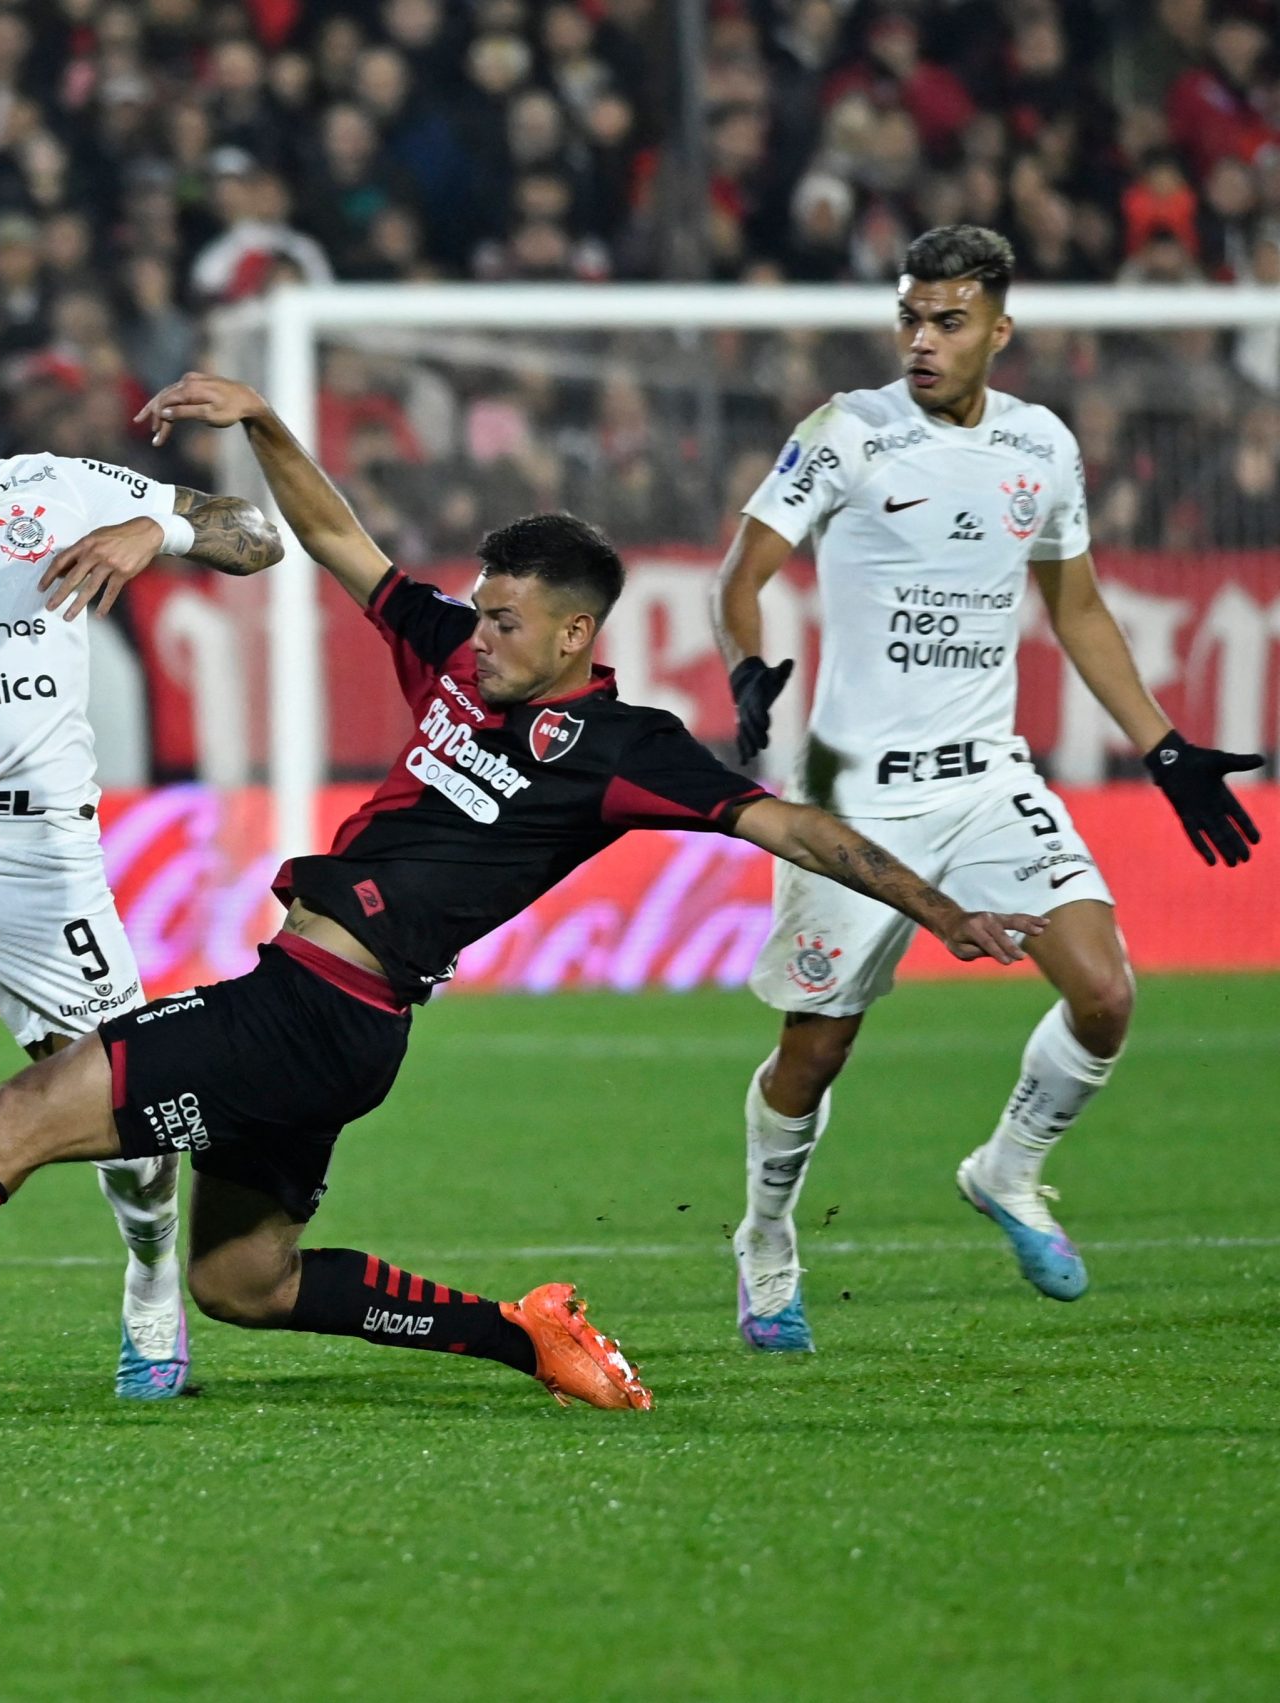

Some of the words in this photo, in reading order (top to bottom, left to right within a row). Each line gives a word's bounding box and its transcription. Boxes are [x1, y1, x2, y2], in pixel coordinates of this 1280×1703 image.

[791, 447, 840, 494] bmg
[948, 531, 986, 541] ALE
[894, 584, 1014, 610] vitaminas
[889, 610, 960, 637] neo
[887, 638, 1005, 674] química
[439, 674, 486, 723] GIVOVA
[539, 722, 570, 742] NOB
[1012, 792, 1059, 837] 5
[63, 918, 109, 981] 9
[136, 997, 205, 1024] GIVOVA
[159, 1098, 184, 1135] DEL
[178, 1092, 212, 1151] CONDO
[363, 1306, 435, 1336] GIVOVA
